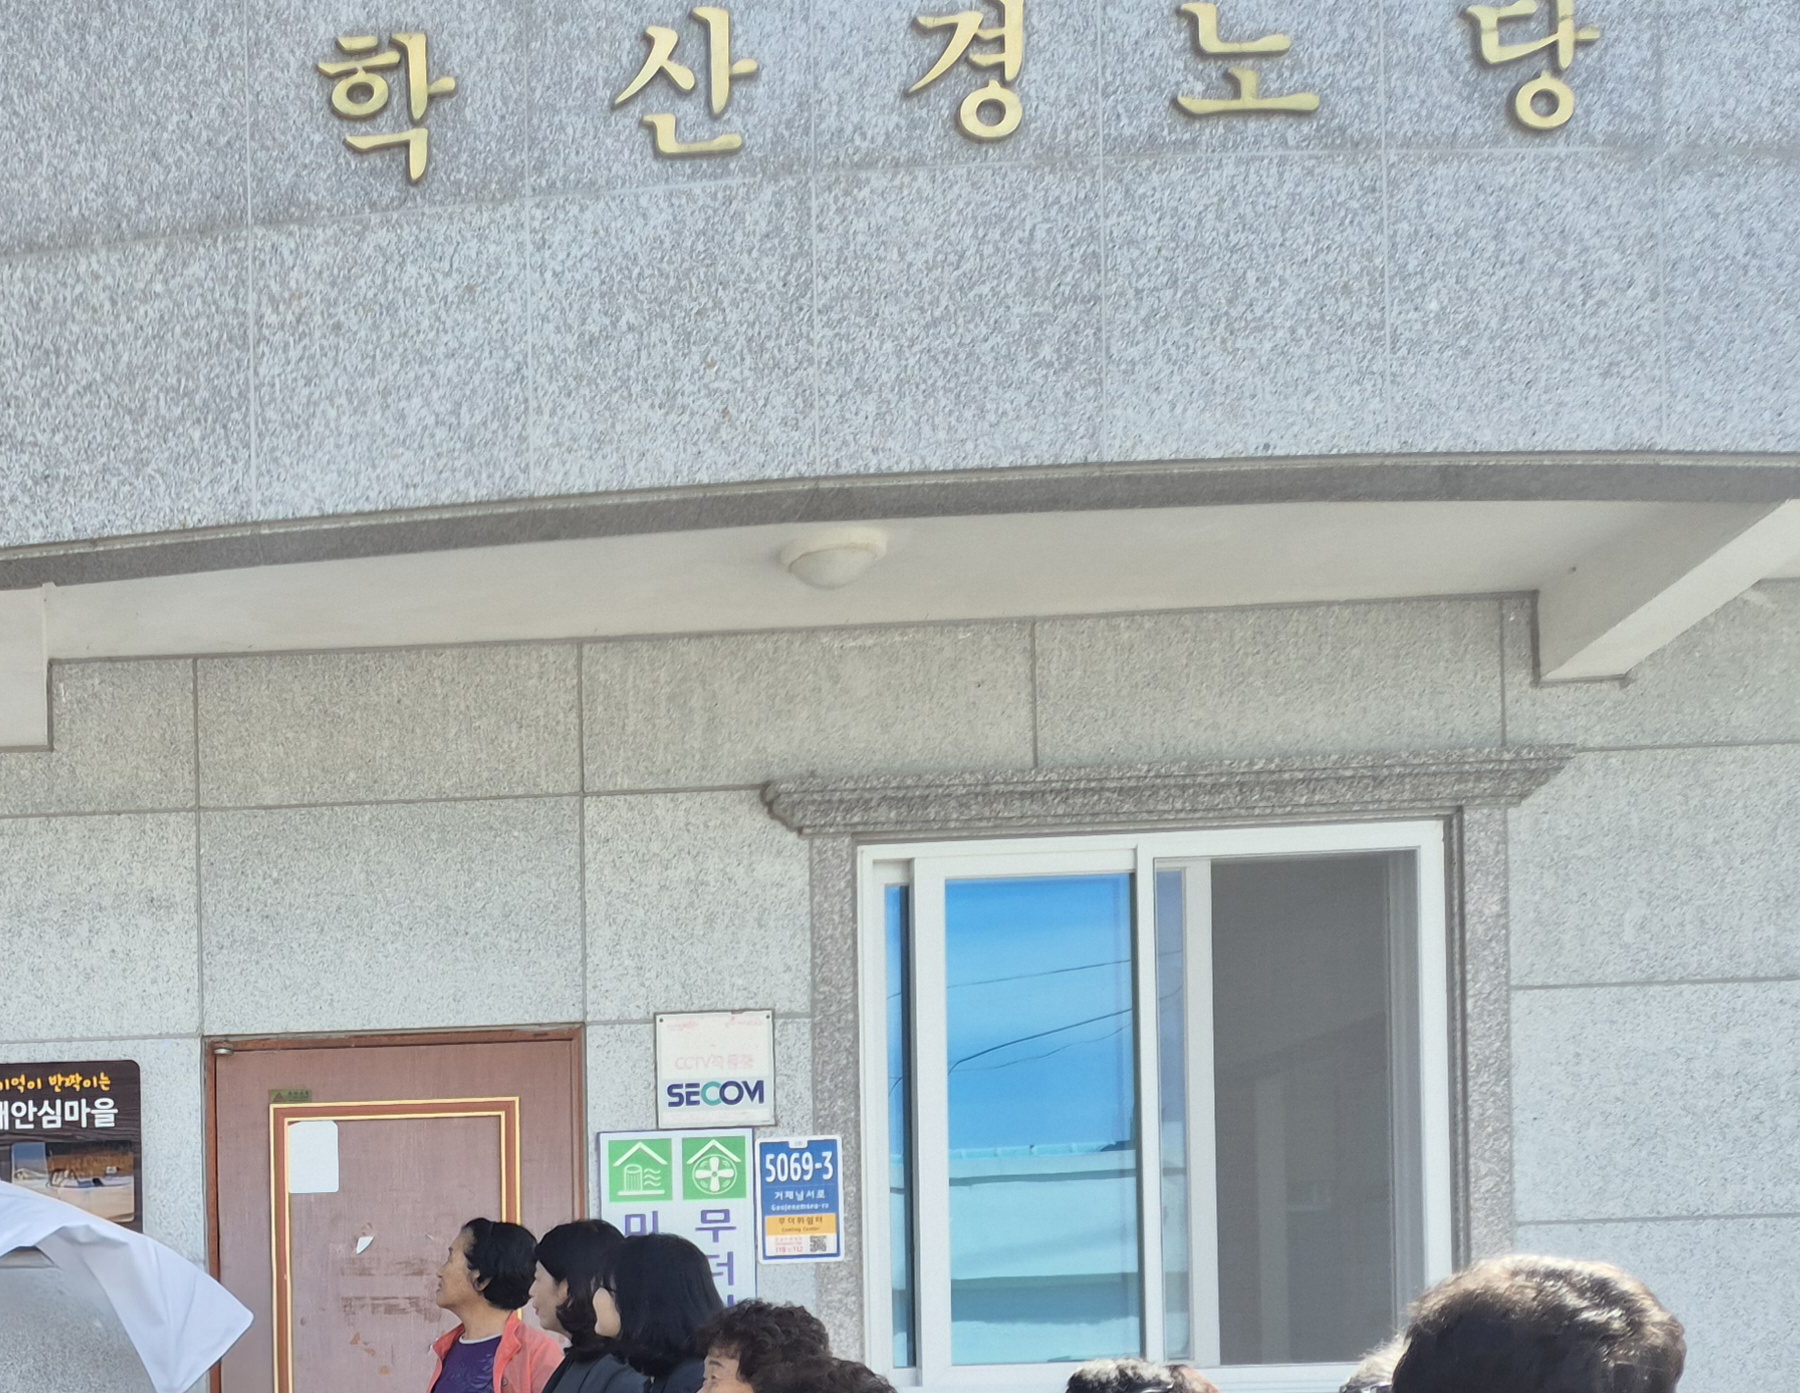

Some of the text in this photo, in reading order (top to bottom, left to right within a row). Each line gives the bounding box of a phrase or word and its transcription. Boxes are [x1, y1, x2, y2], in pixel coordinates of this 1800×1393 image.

[48, 1072, 111, 1092] 반짝이는
[666, 1079, 765, 1108] SECOM
[765, 1151, 834, 1182] 5069-3
[774, 1189, 826, 1201] 거제남서로
[779, 1216, 823, 1225] 무더위쉼터
